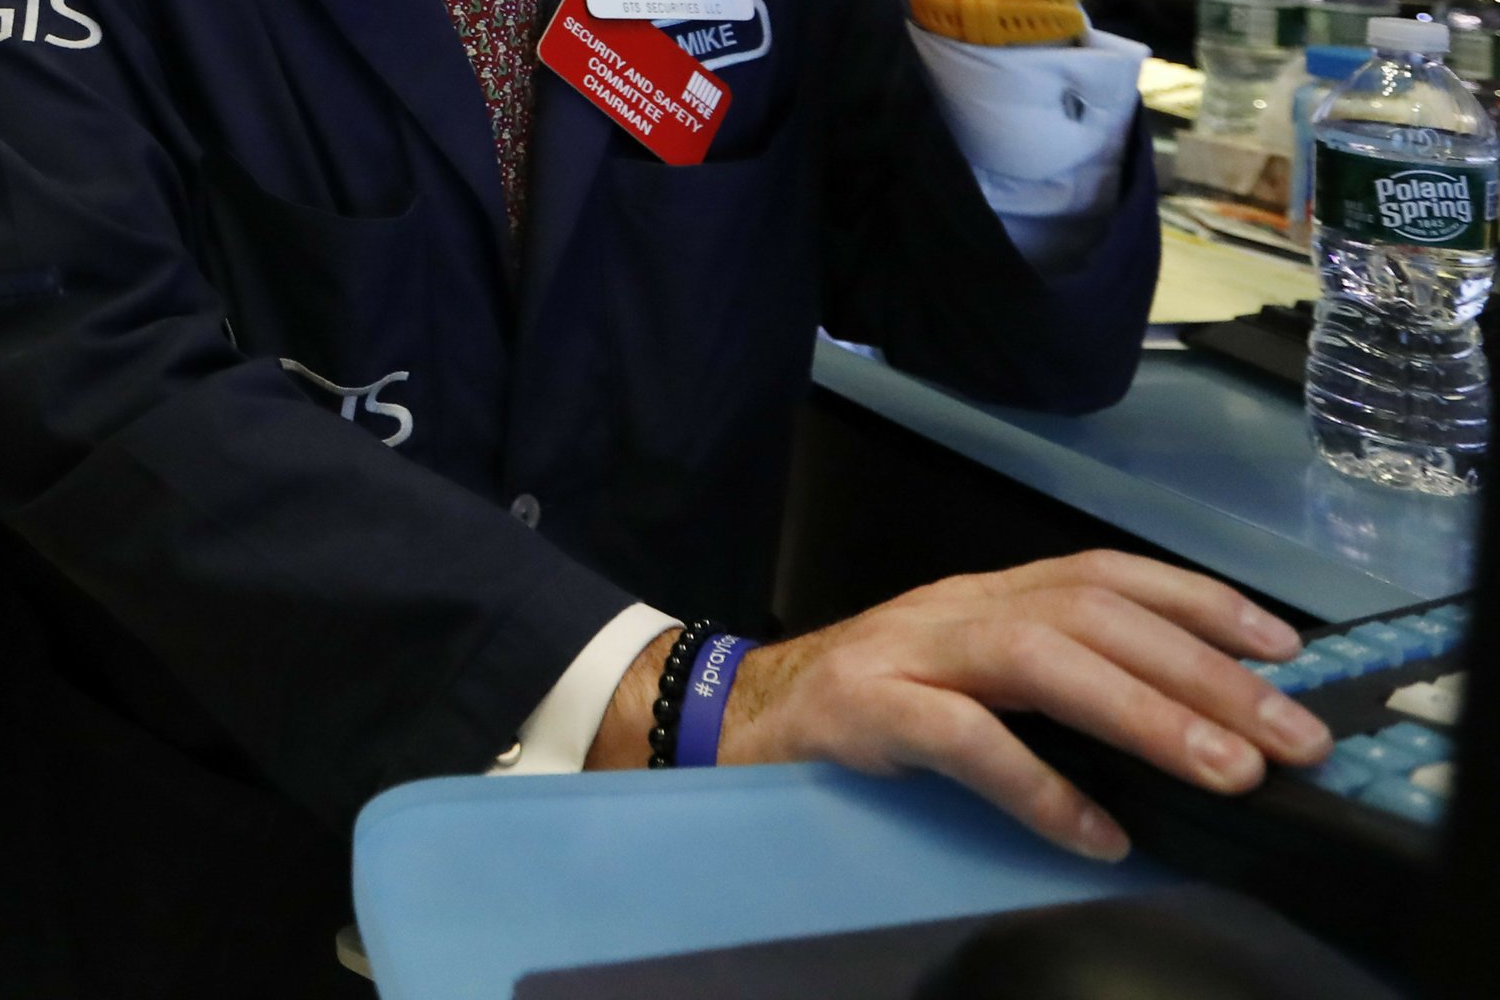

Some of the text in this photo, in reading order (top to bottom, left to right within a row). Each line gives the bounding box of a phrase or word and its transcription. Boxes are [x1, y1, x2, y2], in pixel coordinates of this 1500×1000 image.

[623, 2, 723, 15] GTS SECURITIES LLC
[676, 23, 738, 57] MIKE
[563, 16, 703, 133] SECURITY AND SAFETY
[588, 56, 664, 123] COMMITTEE
[583, 73, 653, 135] CHAIRMAN
[681, 89, 715, 120] NYSE
[1374, 175, 1470, 203] Poland
[1379, 197, 1473, 228] Spring
[279, 358, 413, 447] TS
